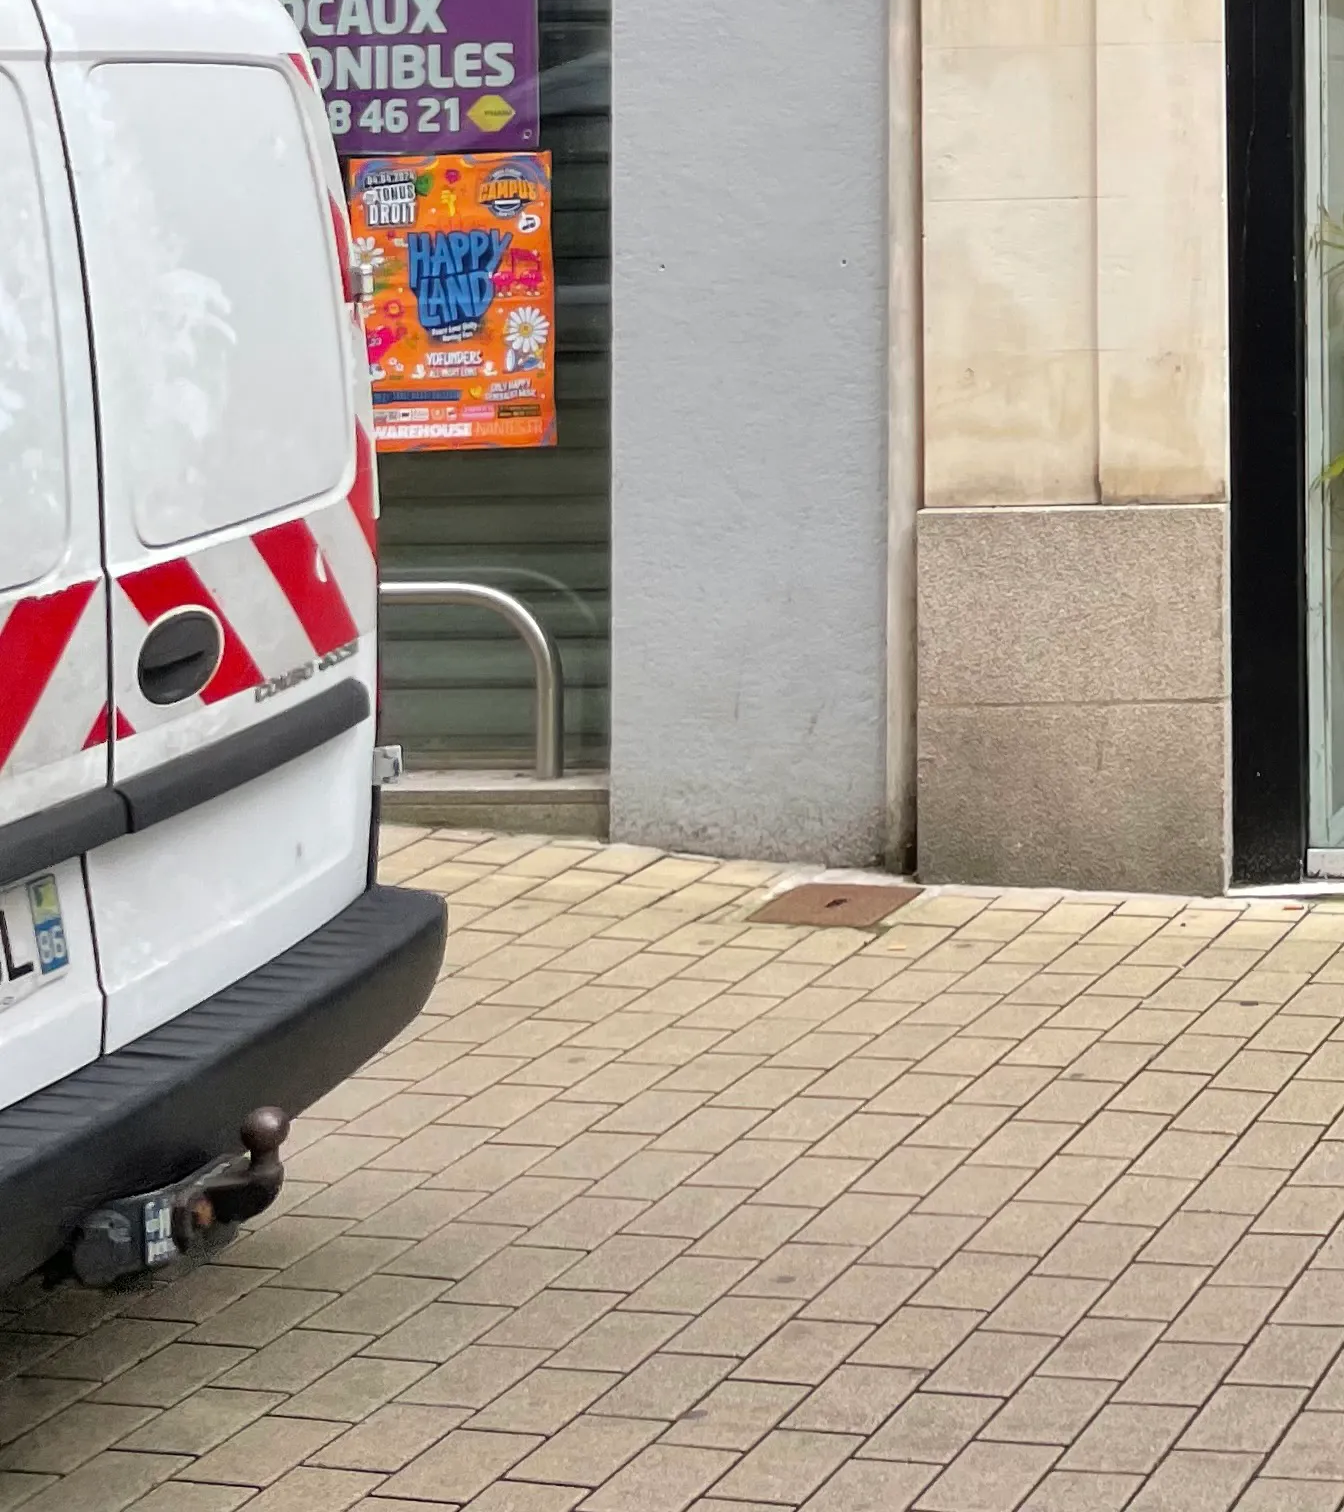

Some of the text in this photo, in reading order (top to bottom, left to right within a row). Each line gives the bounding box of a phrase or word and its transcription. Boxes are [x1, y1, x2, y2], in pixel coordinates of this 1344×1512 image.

[359, 98, 409, 134] 46
[416, 96, 460, 133] 21
[375, 185, 415, 202] TONUS
[478, 178, 537, 204] CAMPUS
[368, 203, 416, 227] DROIT
[406, 228, 513, 289] HAPPY
[419, 270, 496, 329] LAND
[374, 422, 472, 438] WAREHOUSE
[0, 910, 35, 984] L
